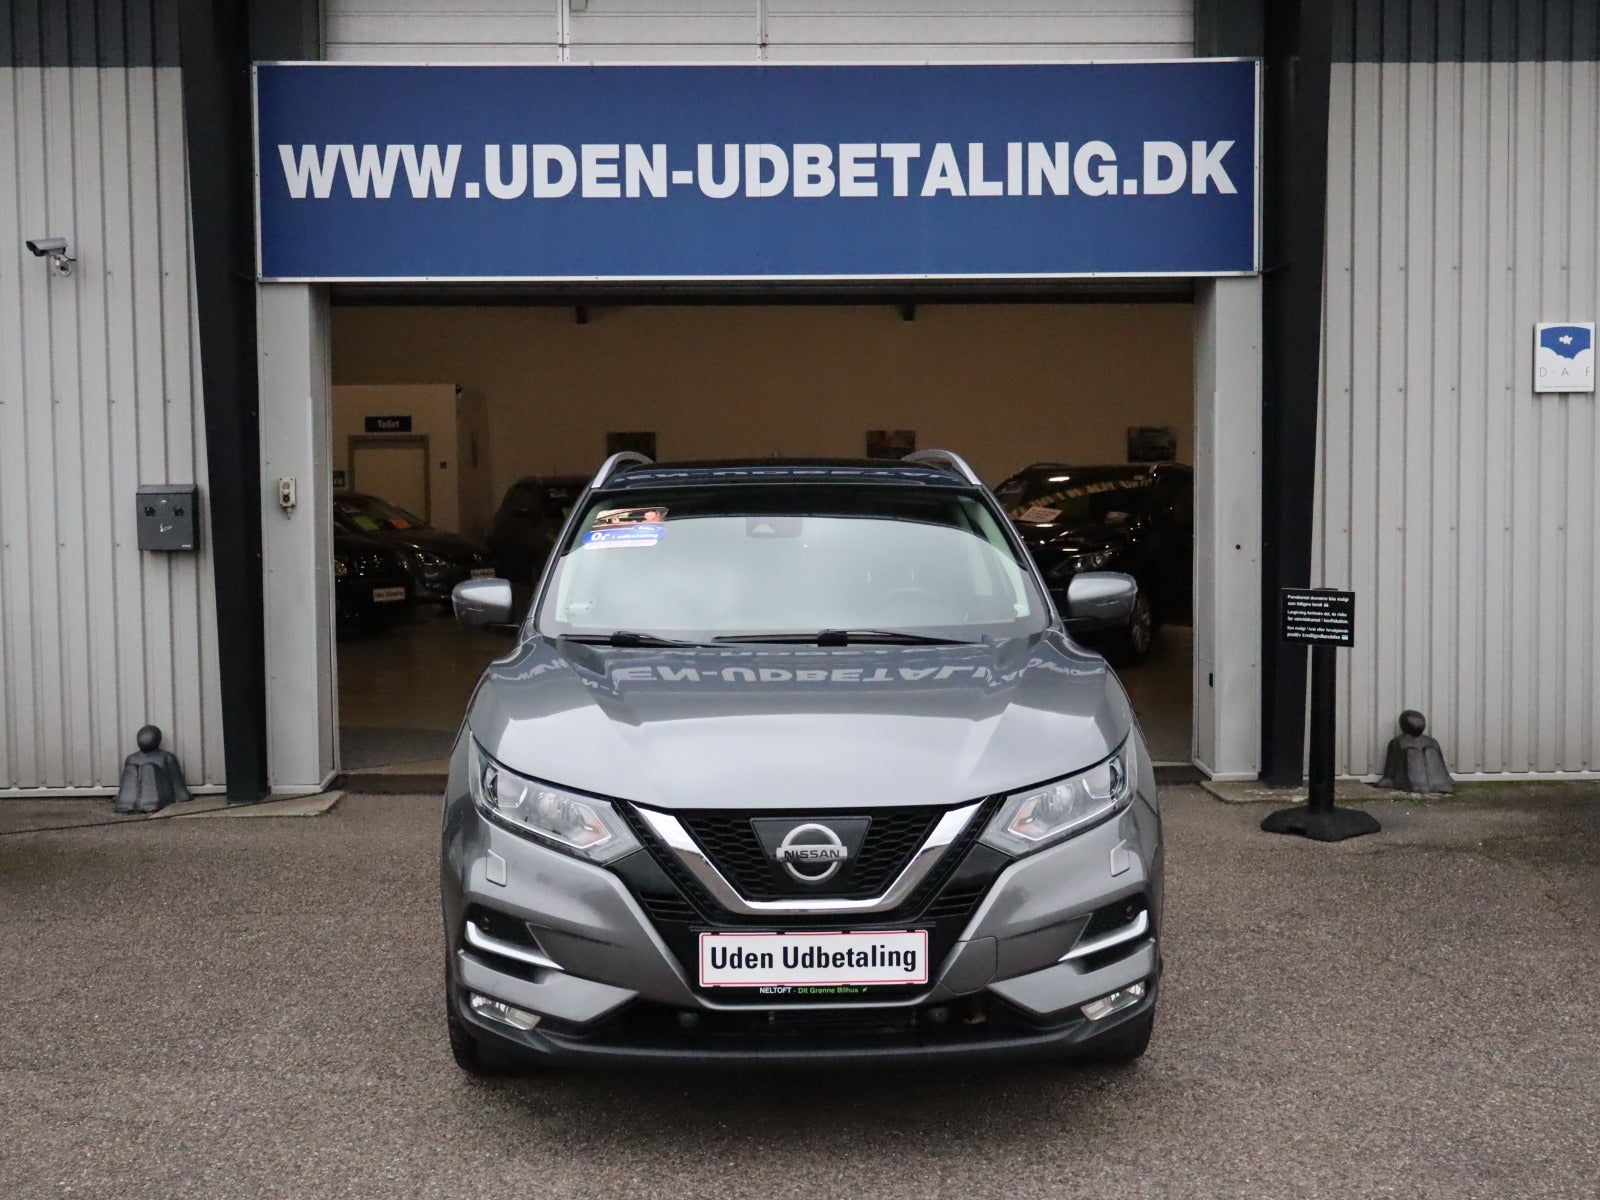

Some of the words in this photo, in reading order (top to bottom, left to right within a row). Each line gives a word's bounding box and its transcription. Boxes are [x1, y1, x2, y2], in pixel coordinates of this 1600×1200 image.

[278, 139, 1238, 200] WWW.UDEN-UDBETALING.DK
[784, 849, 840, 859] NISSAN
[711, 945, 774, 969] Uden
[782, 944, 917, 972] Udbetaling
[759, 986, 792, 994] NELTOFT
